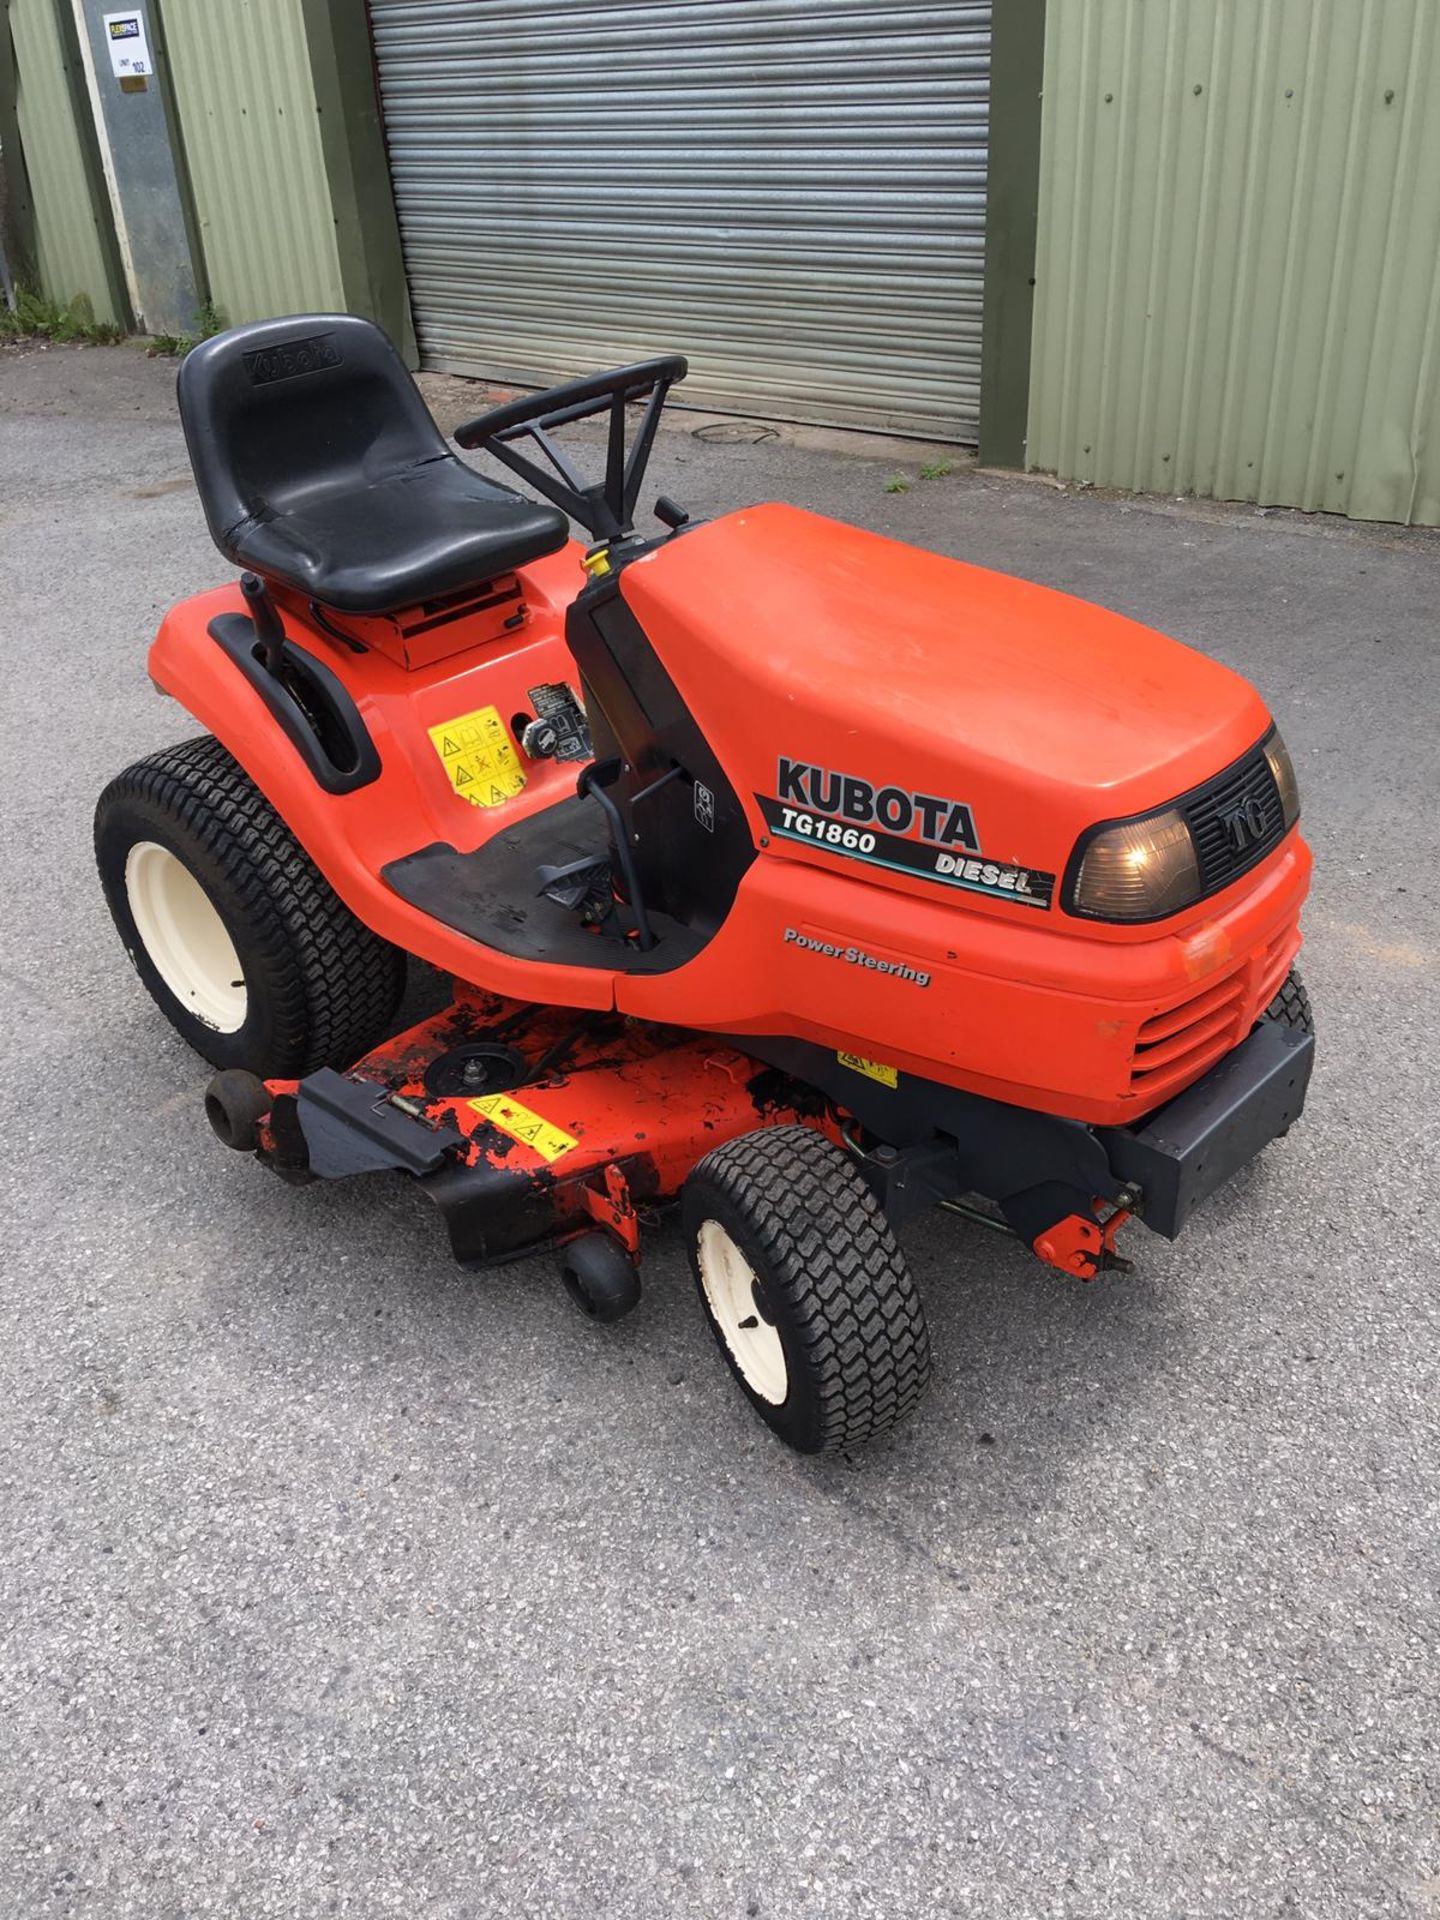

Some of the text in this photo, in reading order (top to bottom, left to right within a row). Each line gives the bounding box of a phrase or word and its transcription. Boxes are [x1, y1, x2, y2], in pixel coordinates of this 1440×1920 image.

[132, 61, 145, 73] 102
[777, 755, 982, 855] KUBOTA
[782, 808, 1032, 894] TG1860 DIESEL
